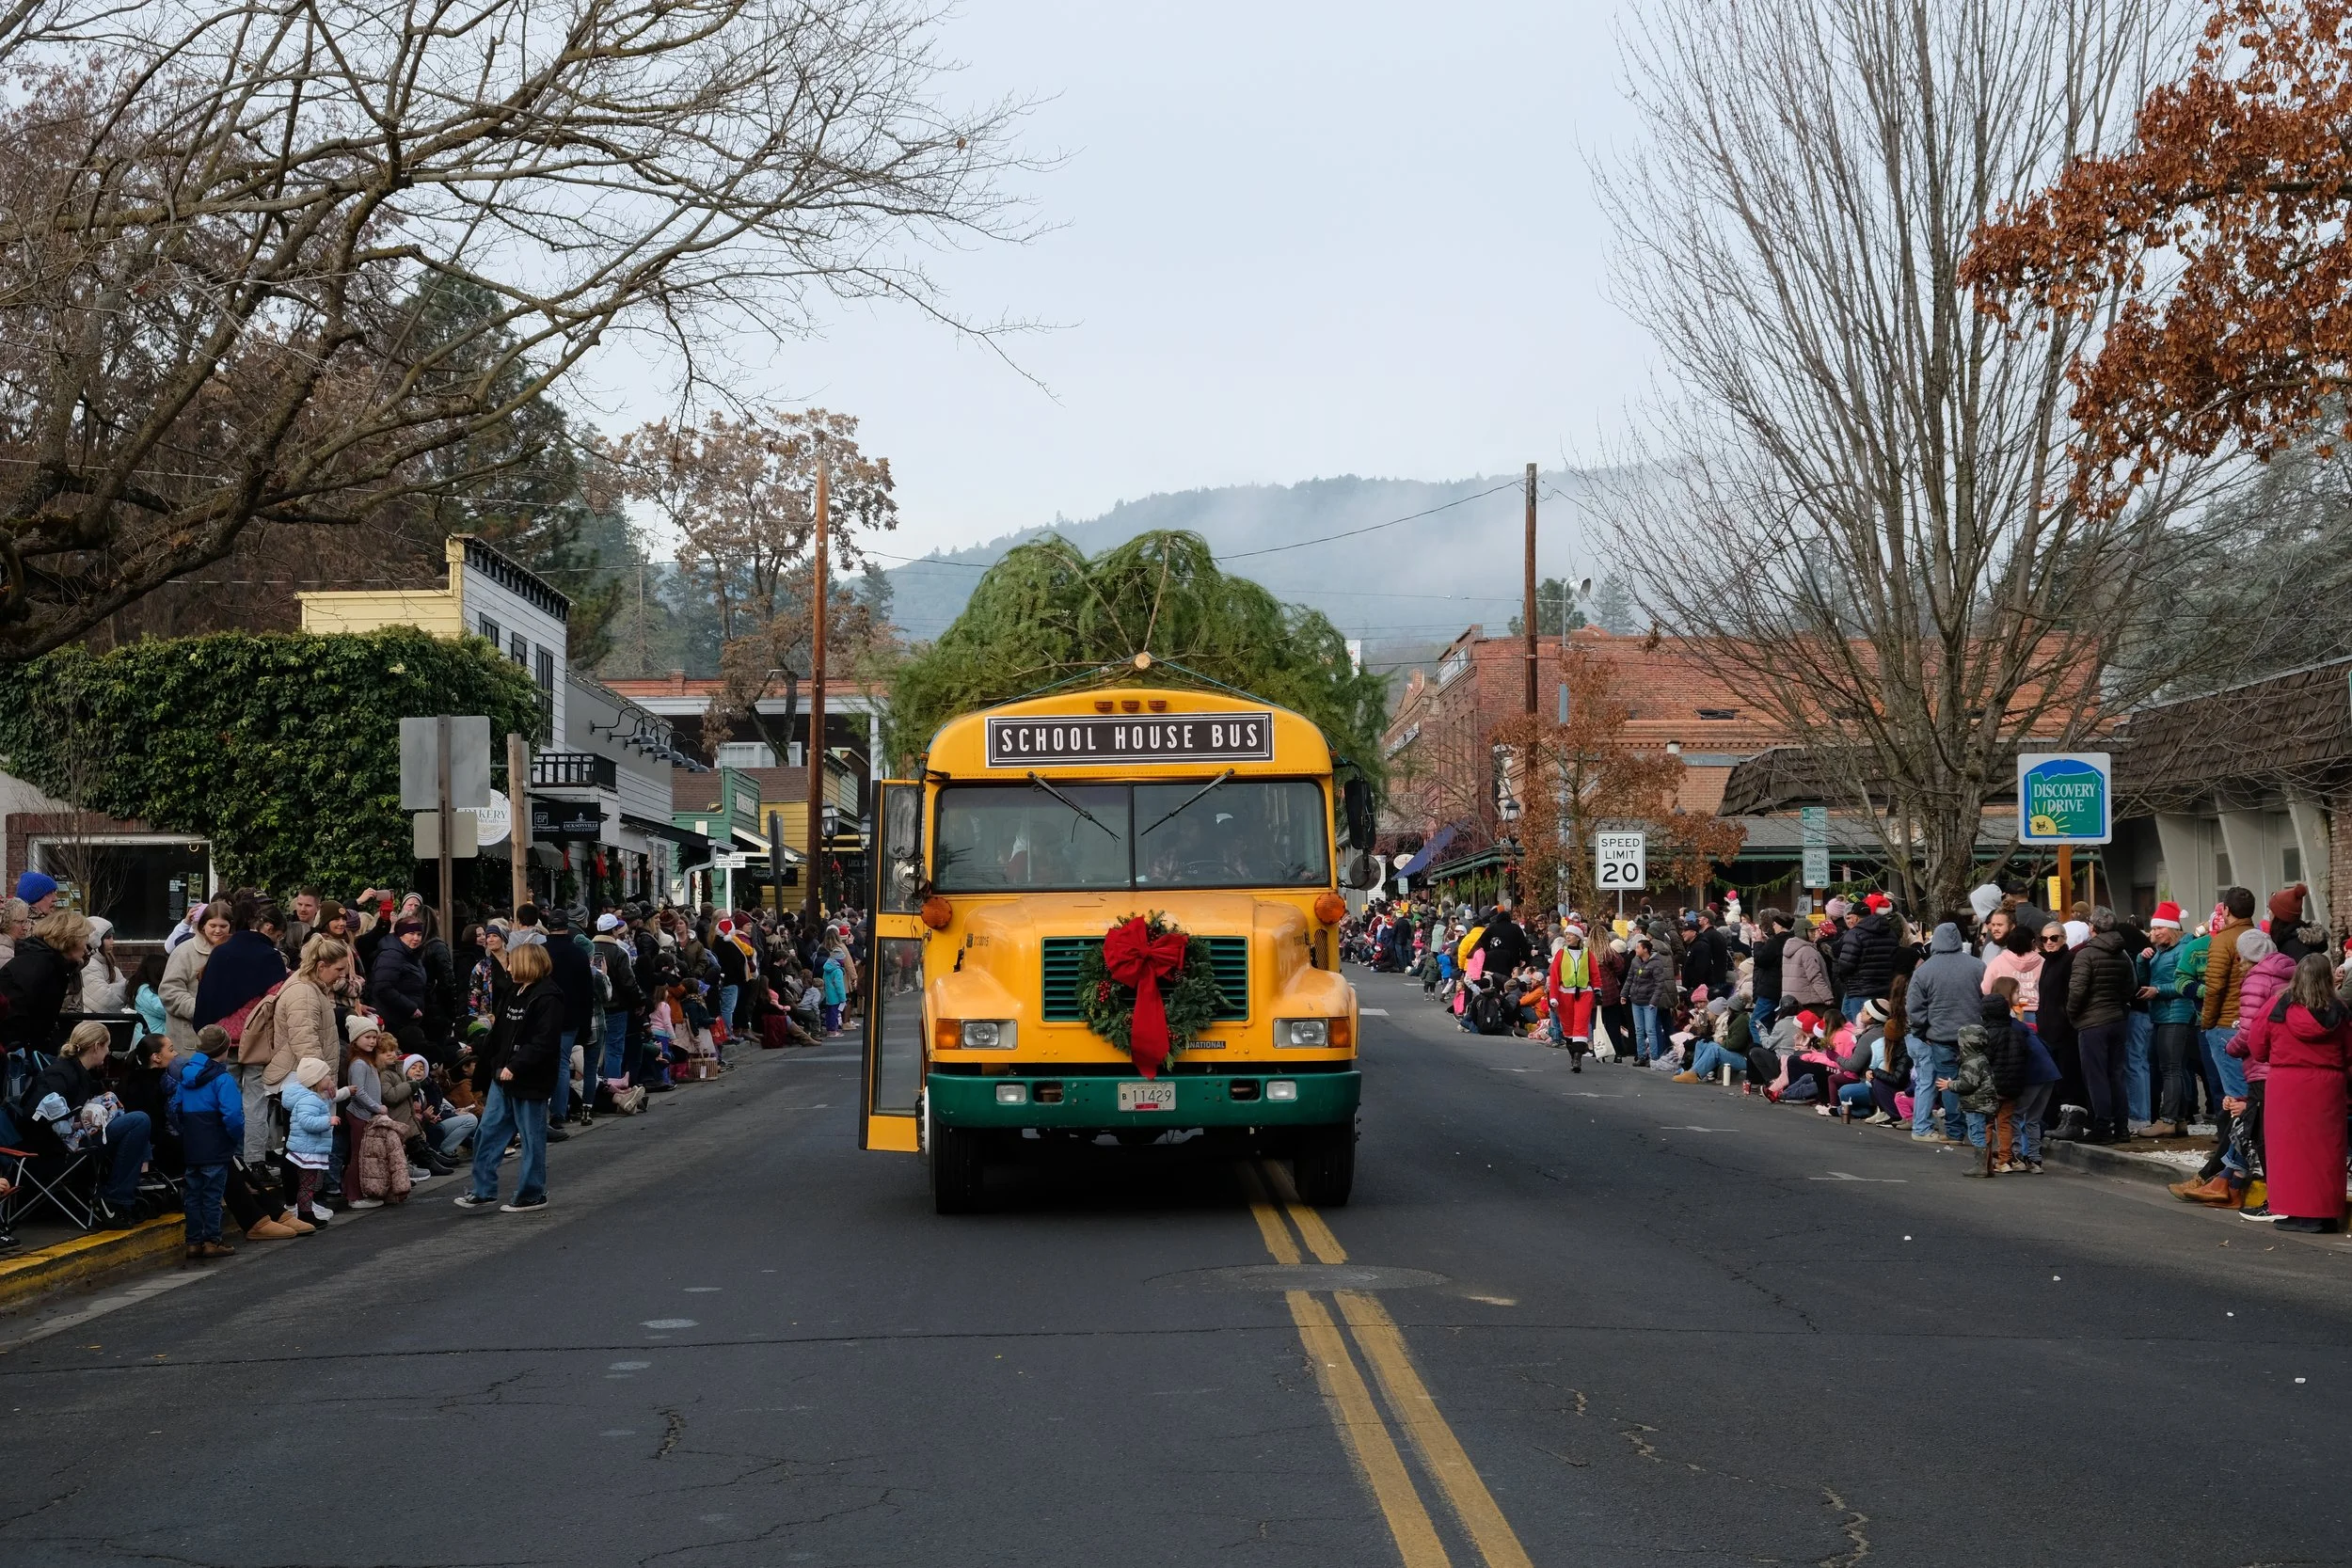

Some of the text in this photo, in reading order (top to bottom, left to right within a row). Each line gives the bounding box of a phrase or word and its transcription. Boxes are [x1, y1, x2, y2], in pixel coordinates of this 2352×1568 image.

[1002, 723, 1258, 752] SCHOOL HOUSE BUS
[2033, 784, 2096, 798] DISCOVERY
[2046, 799, 2085, 812] DRIVE
[1601, 838, 1640, 847] SPEED
[1605, 850, 1635, 859] LIMIT
[1602, 863, 1639, 882] 20
[1133, 1089, 1171, 1102] 11429
